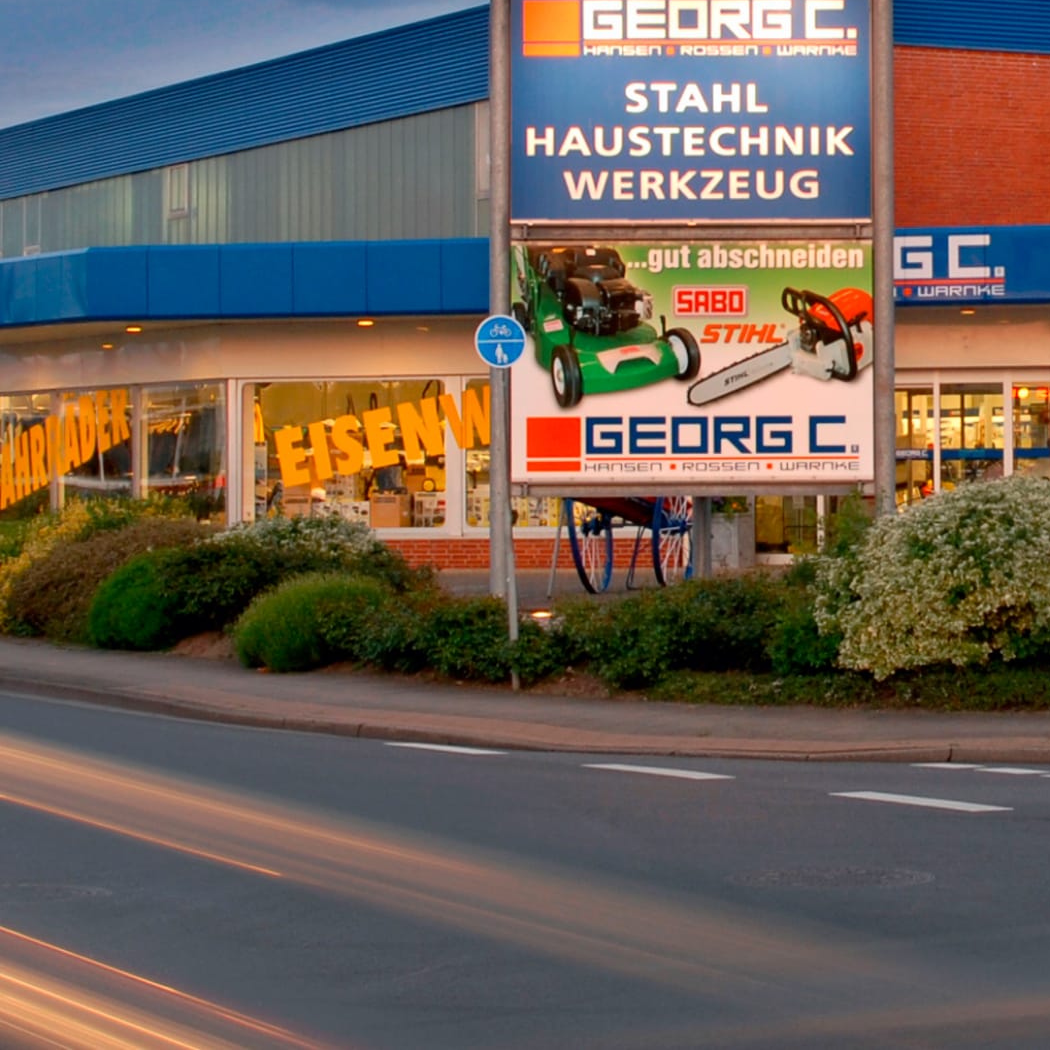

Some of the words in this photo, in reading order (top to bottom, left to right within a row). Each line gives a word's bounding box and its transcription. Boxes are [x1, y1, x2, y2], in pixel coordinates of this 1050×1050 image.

[583, 44, 662, 57] HANSEN
[680, 45, 758, 57] ROSSEN
[776, 44, 858, 57] WARNKE
[624, 81, 768, 113] STAHL
[526, 126, 855, 157] HAUSTECHNIK
[563, 169, 820, 201] WERKZEUG
[627, 246, 690, 273] ...gut
[697, 243, 864, 270] abschneiden
[676, 289, 745, 314] SABO
[917, 284, 1006, 298] WARNKE
[585, 415, 793, 455] GEORG
[584, 461, 663, 473] HANSEN
[682, 461, 760, 472] ROSSEN
[780, 461, 860, 472] WARNKE
